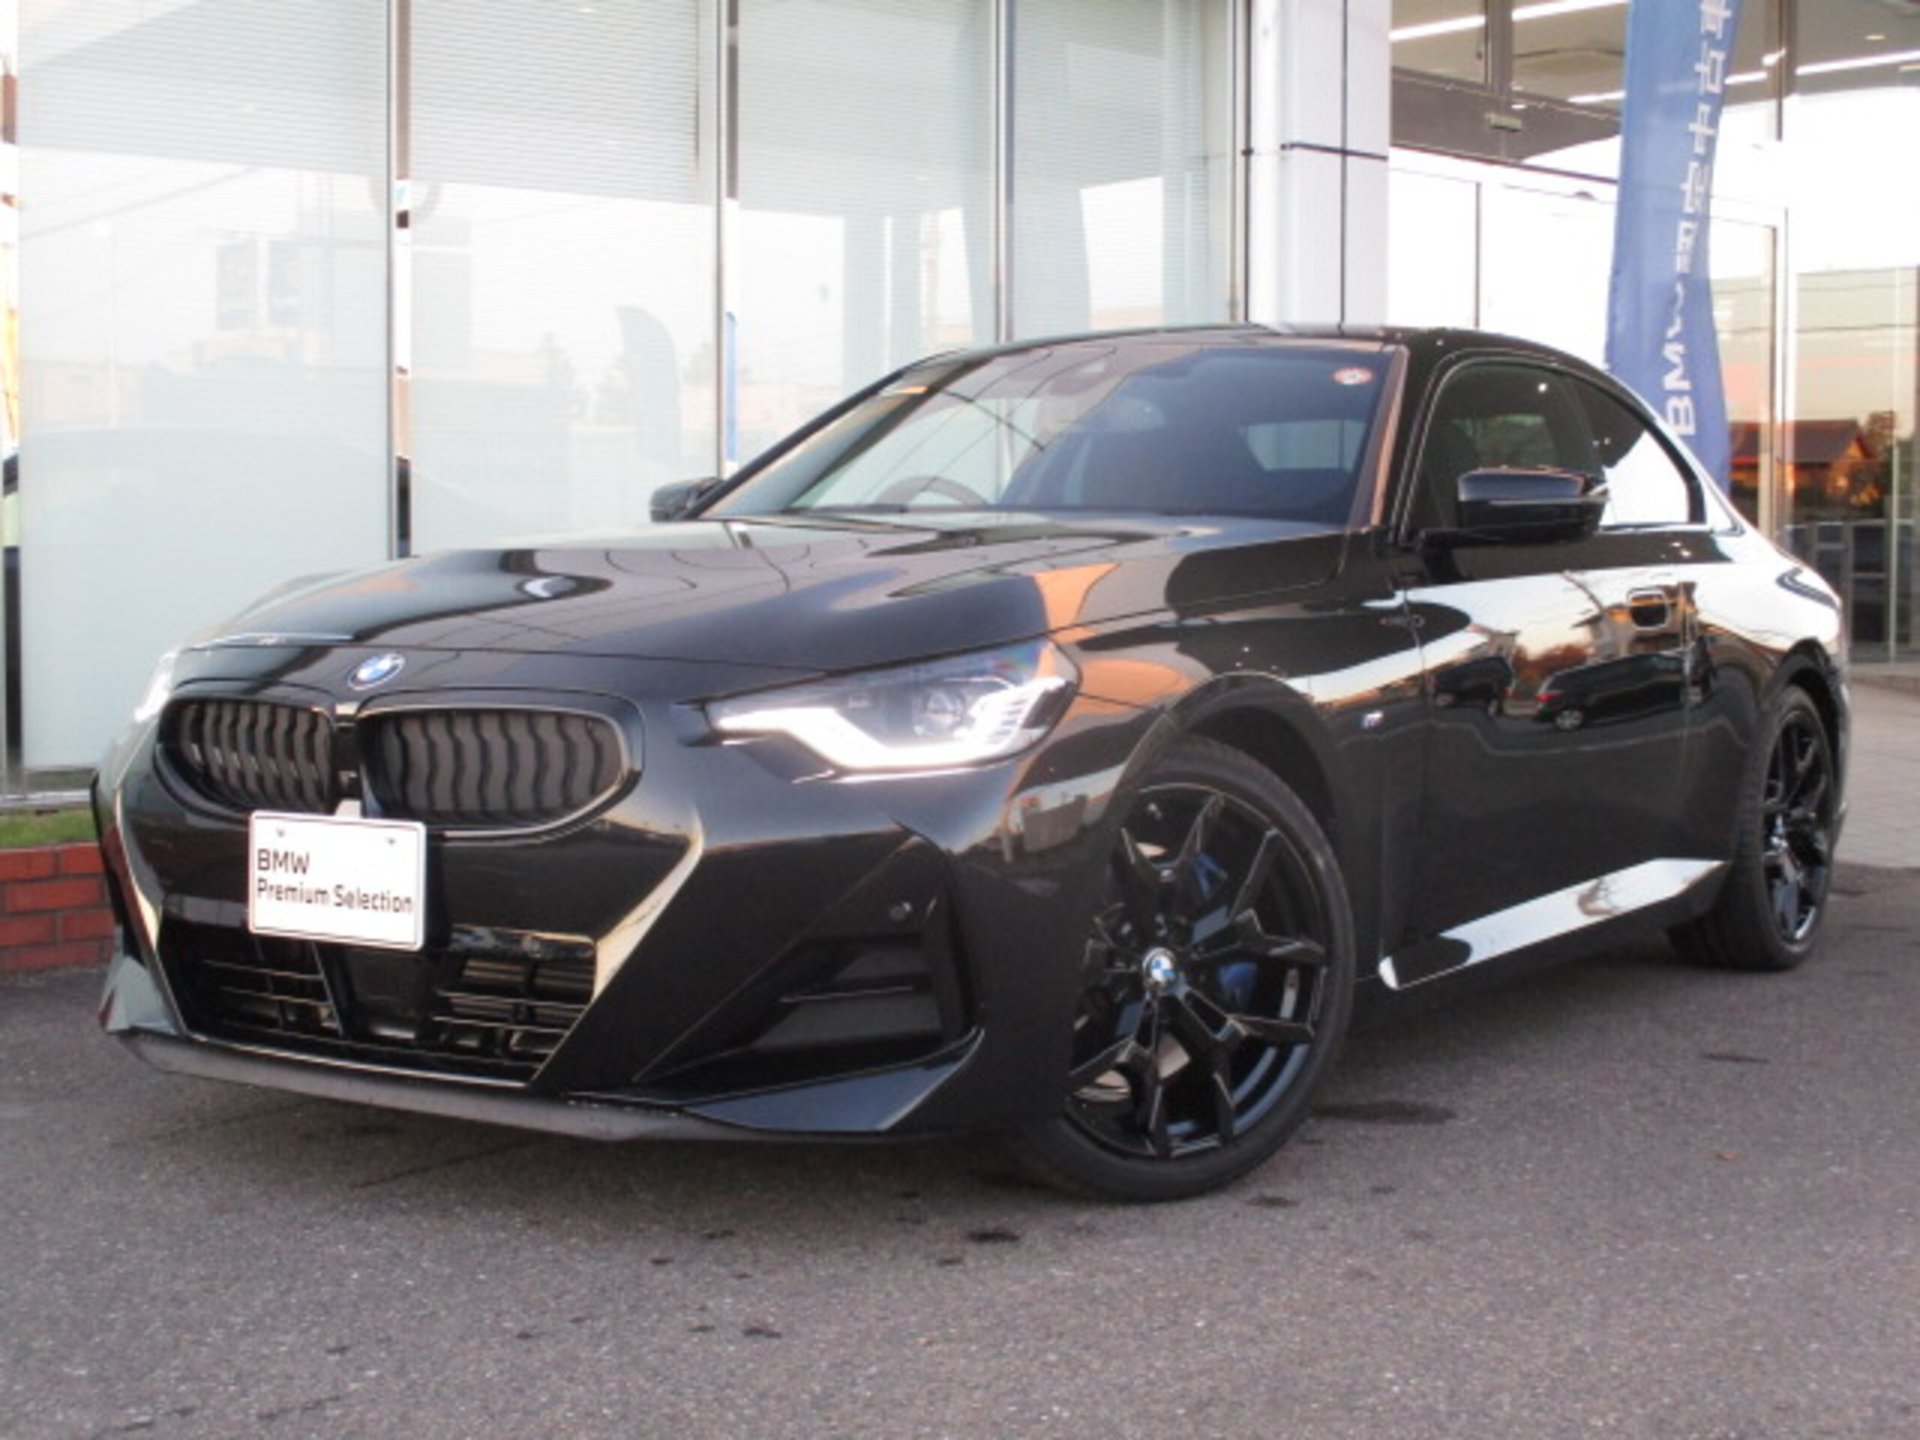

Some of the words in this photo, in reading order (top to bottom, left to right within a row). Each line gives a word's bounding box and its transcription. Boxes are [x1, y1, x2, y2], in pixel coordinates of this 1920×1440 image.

[257, 848, 310, 875] BMW
[257, 877, 330, 905] Premium
[333, 884, 414, 914] Selection
